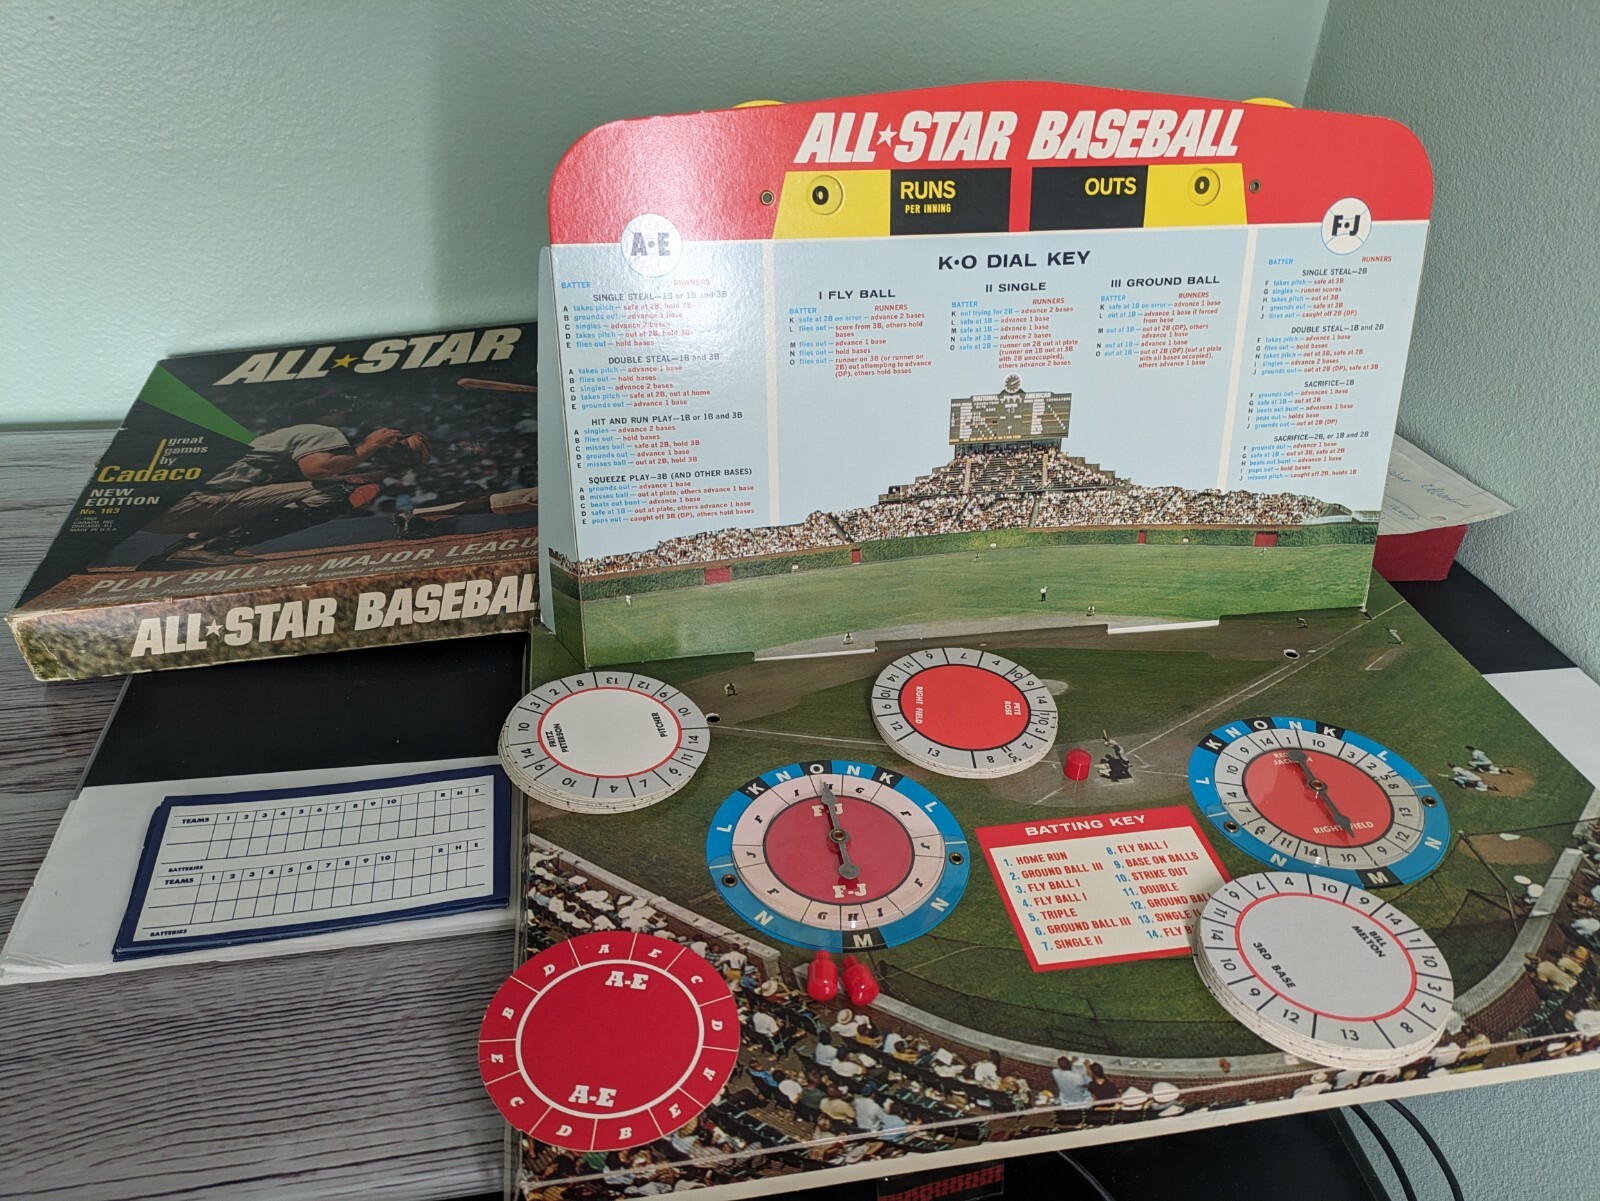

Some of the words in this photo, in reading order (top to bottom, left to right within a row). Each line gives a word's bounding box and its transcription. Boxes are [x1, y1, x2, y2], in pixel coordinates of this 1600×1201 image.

[1027, 109, 1244, 161] BASEBALL
[900, 180, 956, 199] RUNS
[1084, 177, 1137, 196] OUTS
[905, 205, 921, 214] PER
[923, 204, 951, 213] INNING
[987, 254, 1036, 268] DIAL
[1047, 251, 1090, 266] KEY
[998, 282, 1046, 292] SINGLE
[1126, 277, 1182, 287] GROUND
[1187, 276, 1220, 285] BALL
[829, 291, 853, 299] FLY
[860, 289, 896, 298] BALL
[608, 355, 642, 366] DOUBLE
[692, 353, 707, 362] and
[709, 353, 720, 361] 3B
[854, 368, 875, 376] others
[591, 418, 606, 426] HIT
[609, 417, 627, 425] AND
[631, 416, 649, 424] RUN
[716, 412, 730, 420] and
[168, 436, 204, 446] great
[164, 446, 208, 456] games
[98, 439, 202, 483] Cadaco
[159, 456, 176, 466] by
[588, 475, 626, 485] SQUEEZE
[671, 471, 691, 481] (AND
[695, 470, 721, 479] OTHER
[724, 468, 752, 477] BASES)
[90, 488, 134, 497] NEW
[85, 497, 160, 507] EDITION
[85, 575, 176, 596] PLAY
[182, 567, 258, 585] BALL
[264, 563, 314, 576] with
[319, 549, 435, 570] MAJOR
[355, 574, 539, 631] BASEBAL
[915, 686, 923, 705] RIGHT
[915, 707, 923, 724] FIELD
[651, 712, 668, 738] PITCHER
[1324, 726, 1336, 737] K
[545, 731, 555, 747] FRITZ
[554, 723, 569, 752] PETERSON
[879, 772, 894, 784] K
[182, 816, 210, 825] TEAMS
[1025, 819, 1103, 836] BATTING
[1109, 815, 1146, 827] KEY
[1106, 846, 1117, 855] 8.
[1117, 843, 1135, 854] FLY
[1137, 841, 1160, 852] BALL
[1004, 858, 1013, 867] 1.
[1016, 854, 1045, 866] HOME
[1046, 852, 1068, 862] RUN
[1114, 860, 1125, 869] 9.
[1125, 856, 1150, 867] BASE
[1153, 855, 1167, 864] ON
[1169, 852, 1199, 863] BALLS
[168, 865, 203, 873] BATTERIES
[1009, 872, 1020, 881] 2.
[1021, 866, 1062, 879] GROUND
[1065, 864, 1090, 875] BALL
[1115, 874, 1131, 883] 10.
[1131, 870, 1166, 881] STRIKE
[1168, 867, 1188, 878] OUT
[164, 877, 194, 886] TEAMS
[1016, 885, 1026, 894] 3.
[1028, 882, 1046, 893] FLY
[1048, 879, 1074, 891] BALL
[832, 883, 866, 899] F-J
[1122, 887, 1139, 897] 11.
[1139, 883, 1180, 895] DOUBLE
[1022, 899, 1032, 908] 4.
[1034, 896, 1053, 907] FLY
[1055, 893, 1080, 904] BALL
[1028, 913, 1039, 922] 5.
[1040, 908, 1078, 921] TRIPLE
[150, 928, 187, 937] BATTERIES
[1035, 927, 1046, 936] 6.
[1047, 921, 1090, 934] GROUND
[1093, 918, 1118, 930] BALL
[853, 934, 873, 948] M
[1041, 941, 1053, 951] 7.
[1054, 937, 1093, 949] SINGLE
[1351, 925, 1386, 958] MELTON
[1369, 930, 1387, 947] BILL
[1253, 942, 1272, 961] 3RD
[1272, 963, 1296, 988] BASE
[605, 971, 649, 990] A-E
[568, 1085, 617, 1107] A-E
